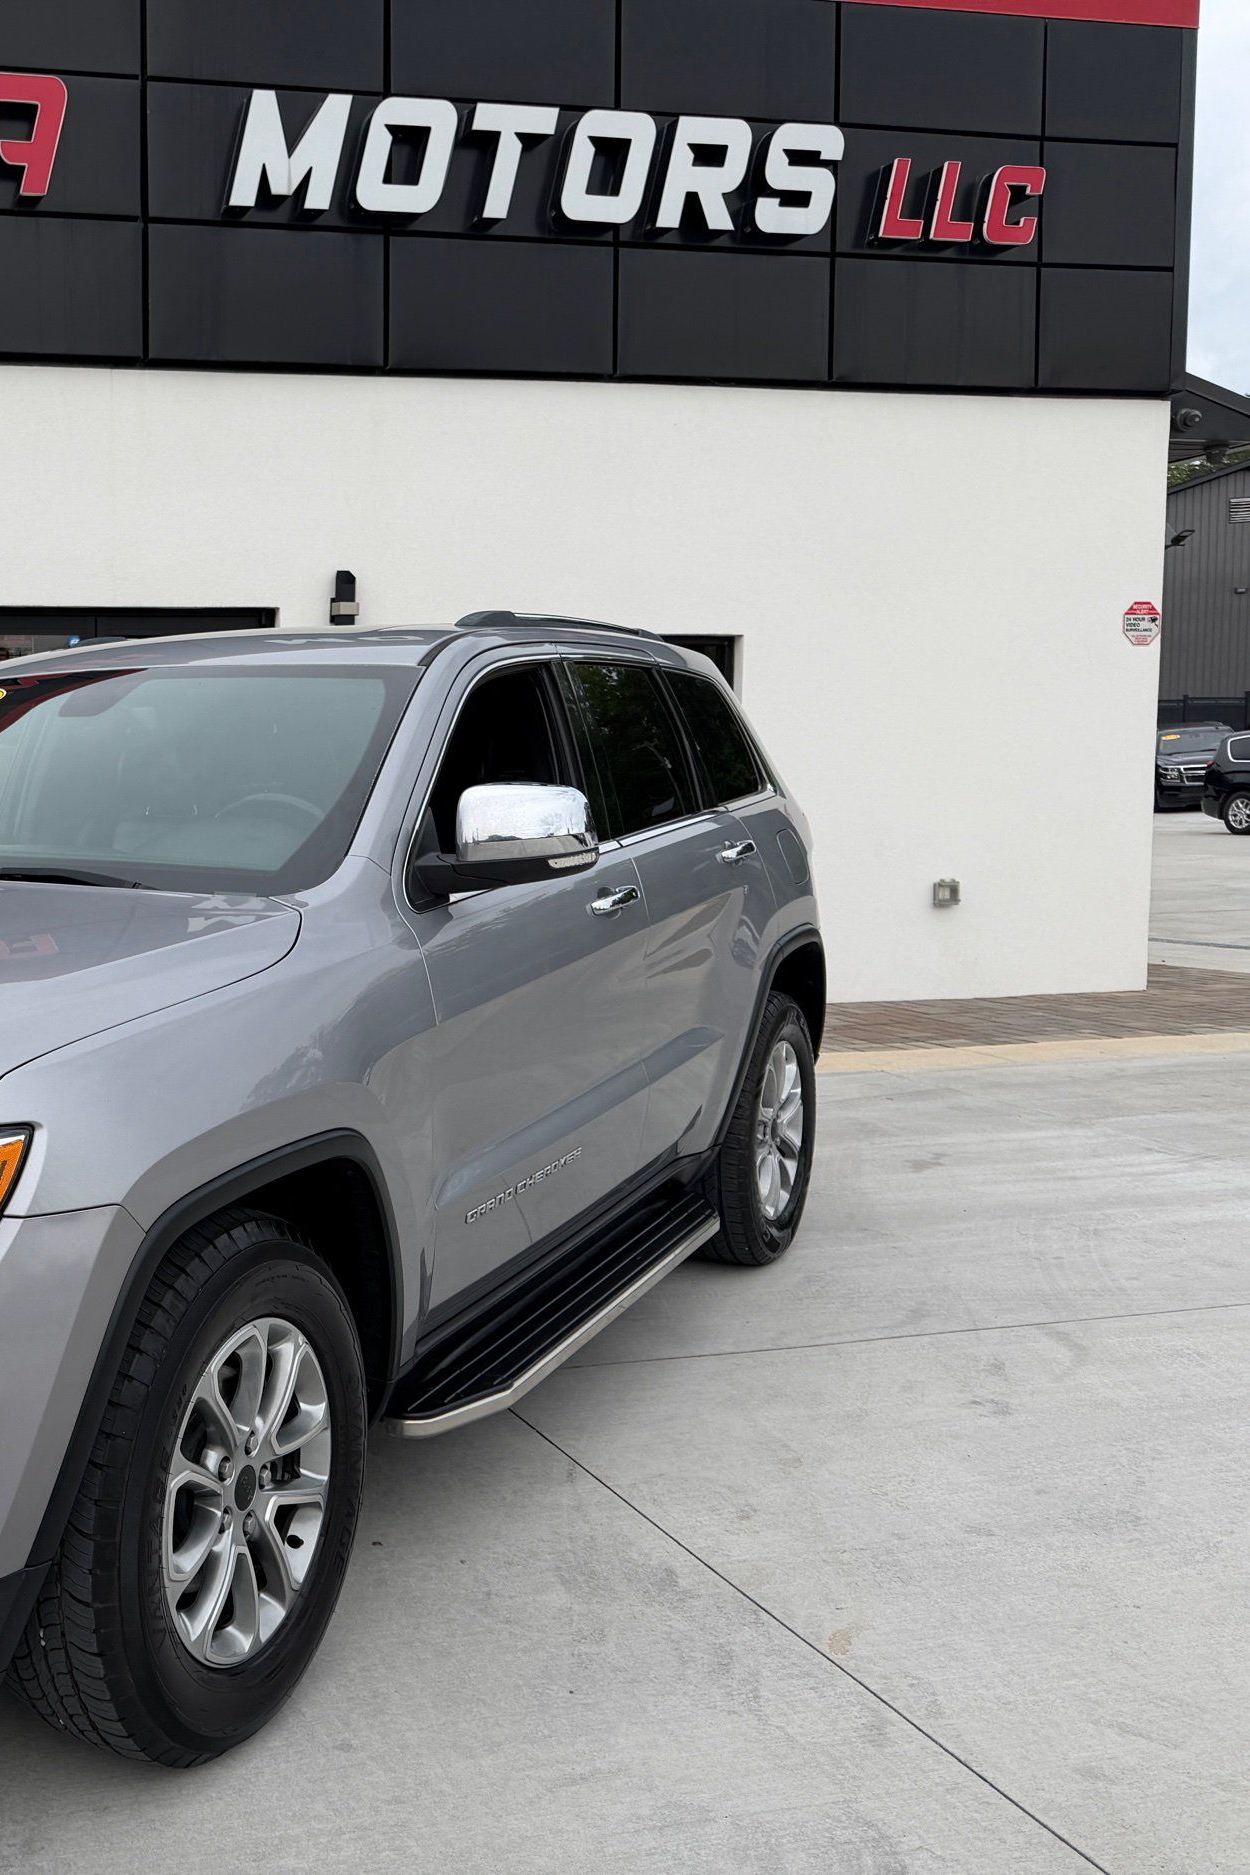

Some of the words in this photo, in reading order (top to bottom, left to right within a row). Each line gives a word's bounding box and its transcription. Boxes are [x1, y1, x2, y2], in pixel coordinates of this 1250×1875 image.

[227, 88, 844, 236] MOTORS
[876, 157, 1046, 246] LLC
[465, 1187, 514, 1224] GRAND
[515, 1146, 582, 1195] CHEROKEE
